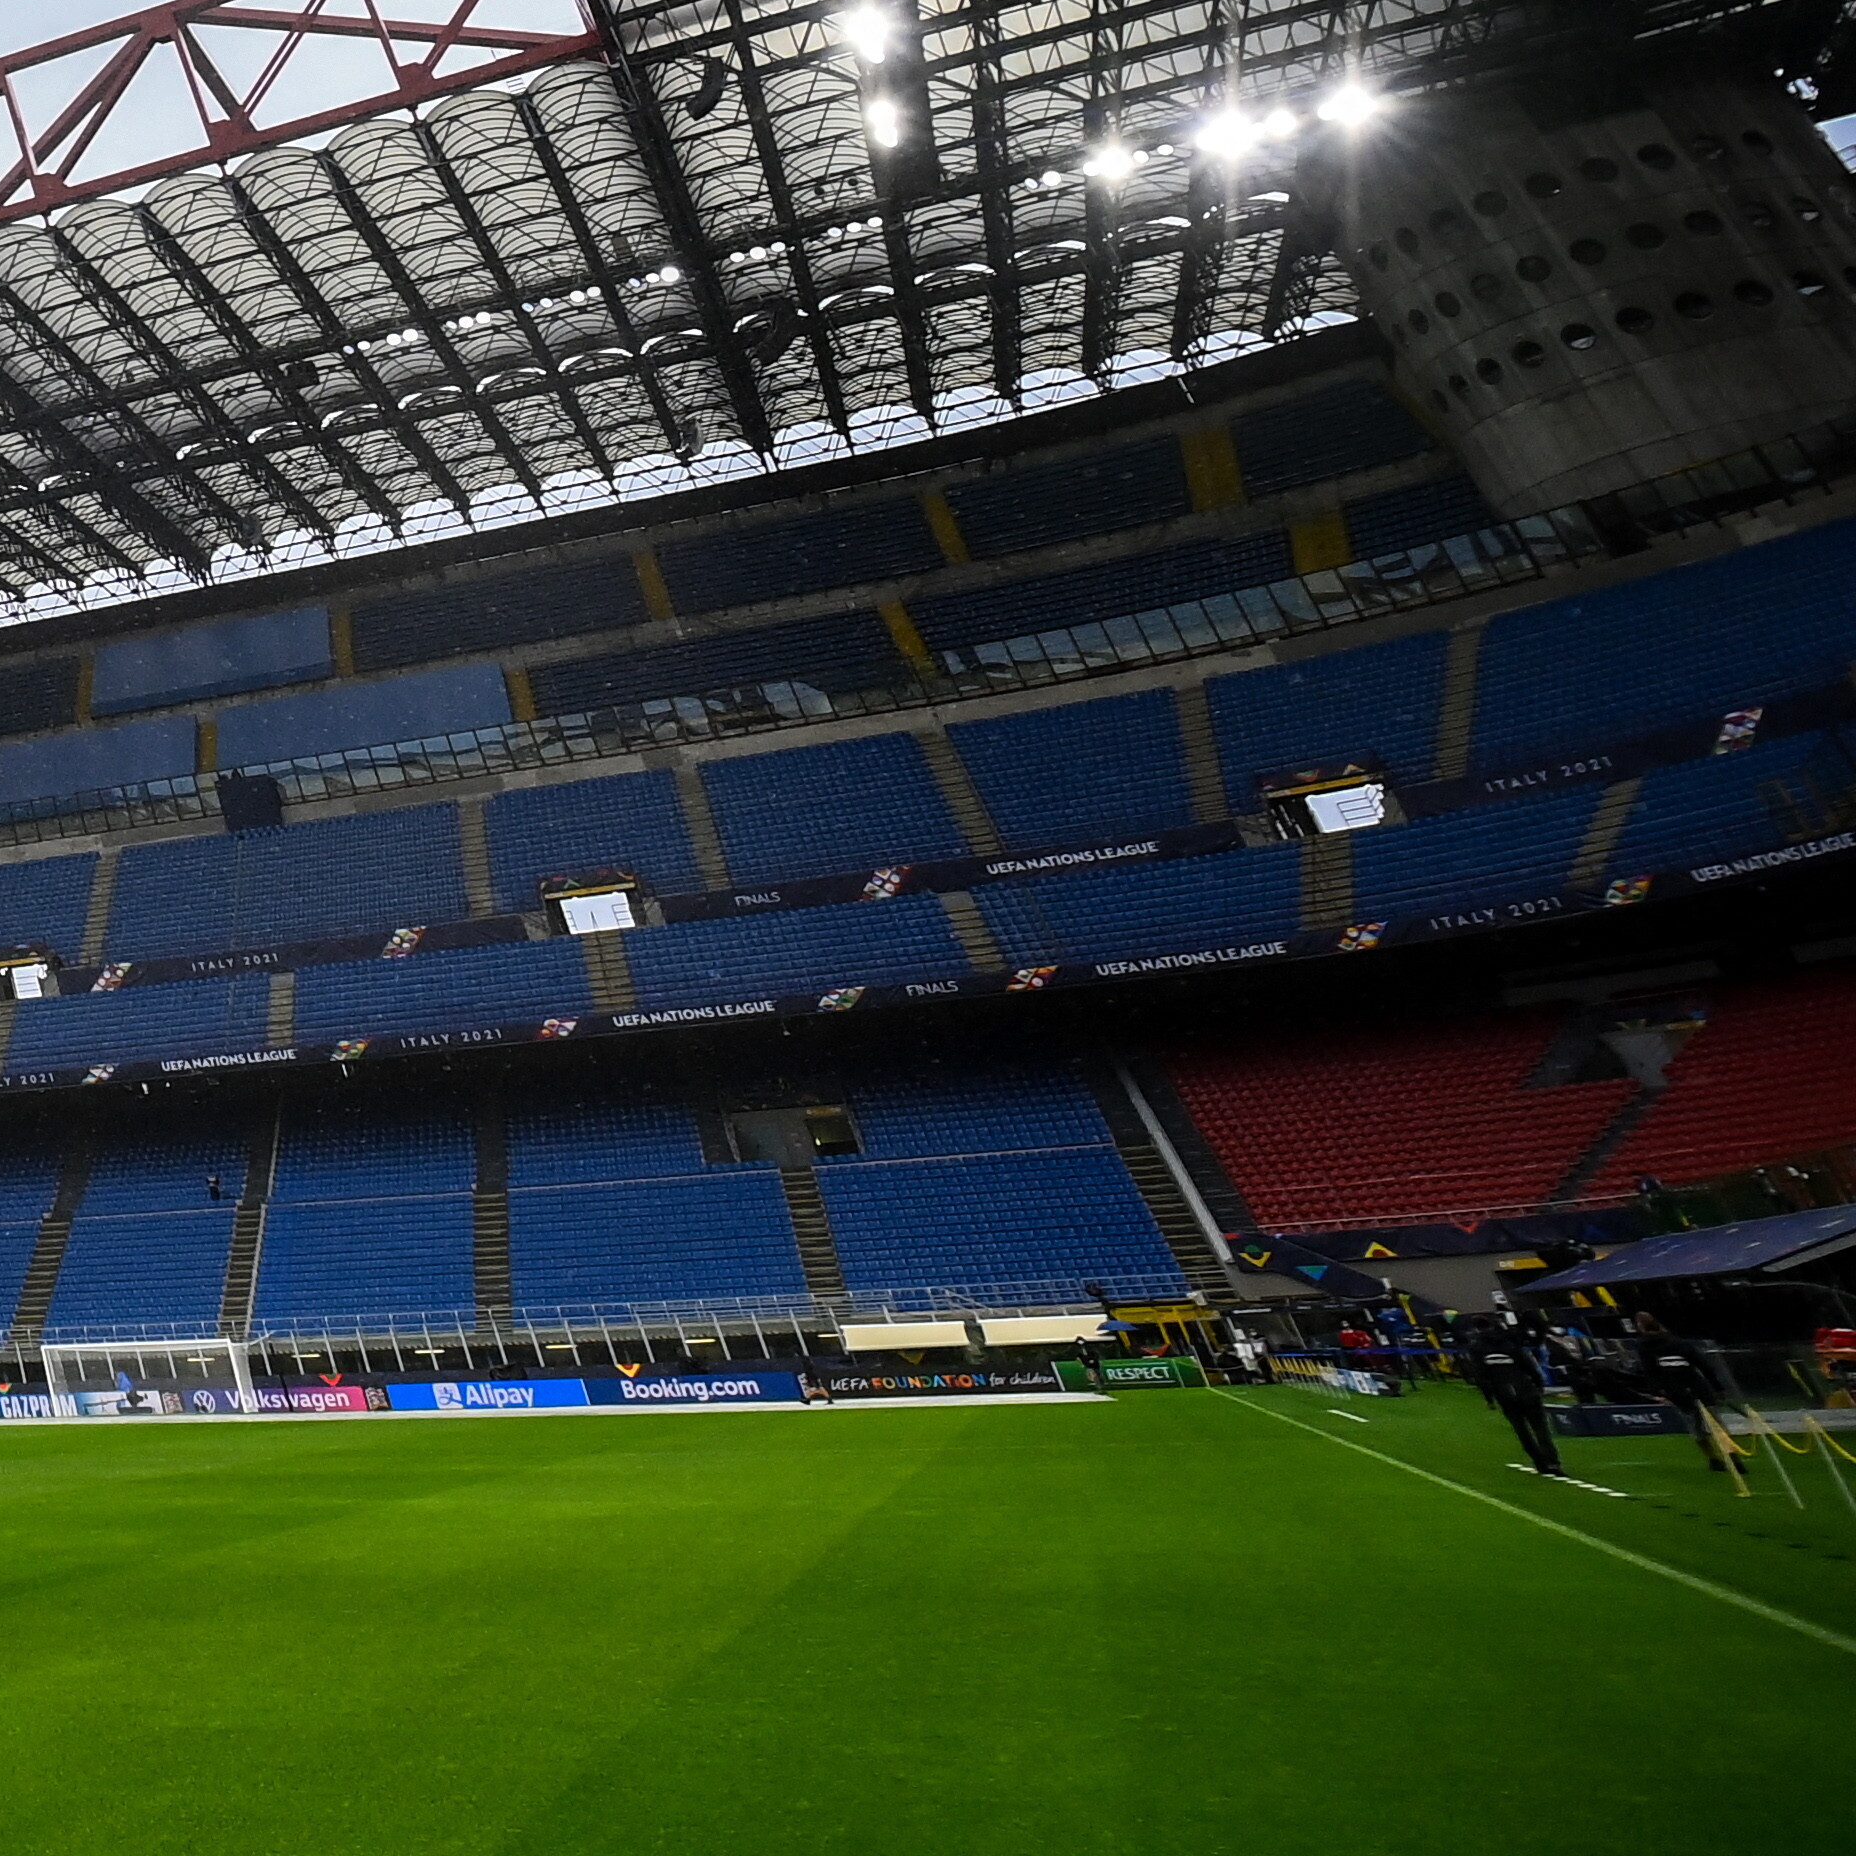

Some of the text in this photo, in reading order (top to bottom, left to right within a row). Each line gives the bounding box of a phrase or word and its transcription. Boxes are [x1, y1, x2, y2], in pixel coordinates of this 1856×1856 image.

[1485, 756, 1612, 793] ITALY 2021
[986, 840, 1159, 875] UEFA NATIONS LEAGUE
[1690, 831, 1856, 882] UEFA NATIONS LEAGUE
[734, 891, 781, 906] FINALS
[1430, 896, 1562, 930] ITALY 2021
[191, 953, 278, 972] ITALY 2021
[1096, 941, 1287, 976] UEFA NATIONS LEAGUE
[905, 981, 959, 996] FINALS
[612, 1000, 775, 1028] UEFA NATIONS LEAGUE
[400, 1028, 503, 1049] ITALY 2021
[161, 1049, 296, 1072] UEFA NATIONS LEAGUE
[20, 1073, 55, 1085] 2021
[830, 1372, 1056, 1391] UEFA FOUNDATION for children
[1106, 1366, 1169, 1380] RESPECT
[466, 1382, 534, 1408] Alipay
[620, 1377, 761, 1401] Booking.com
